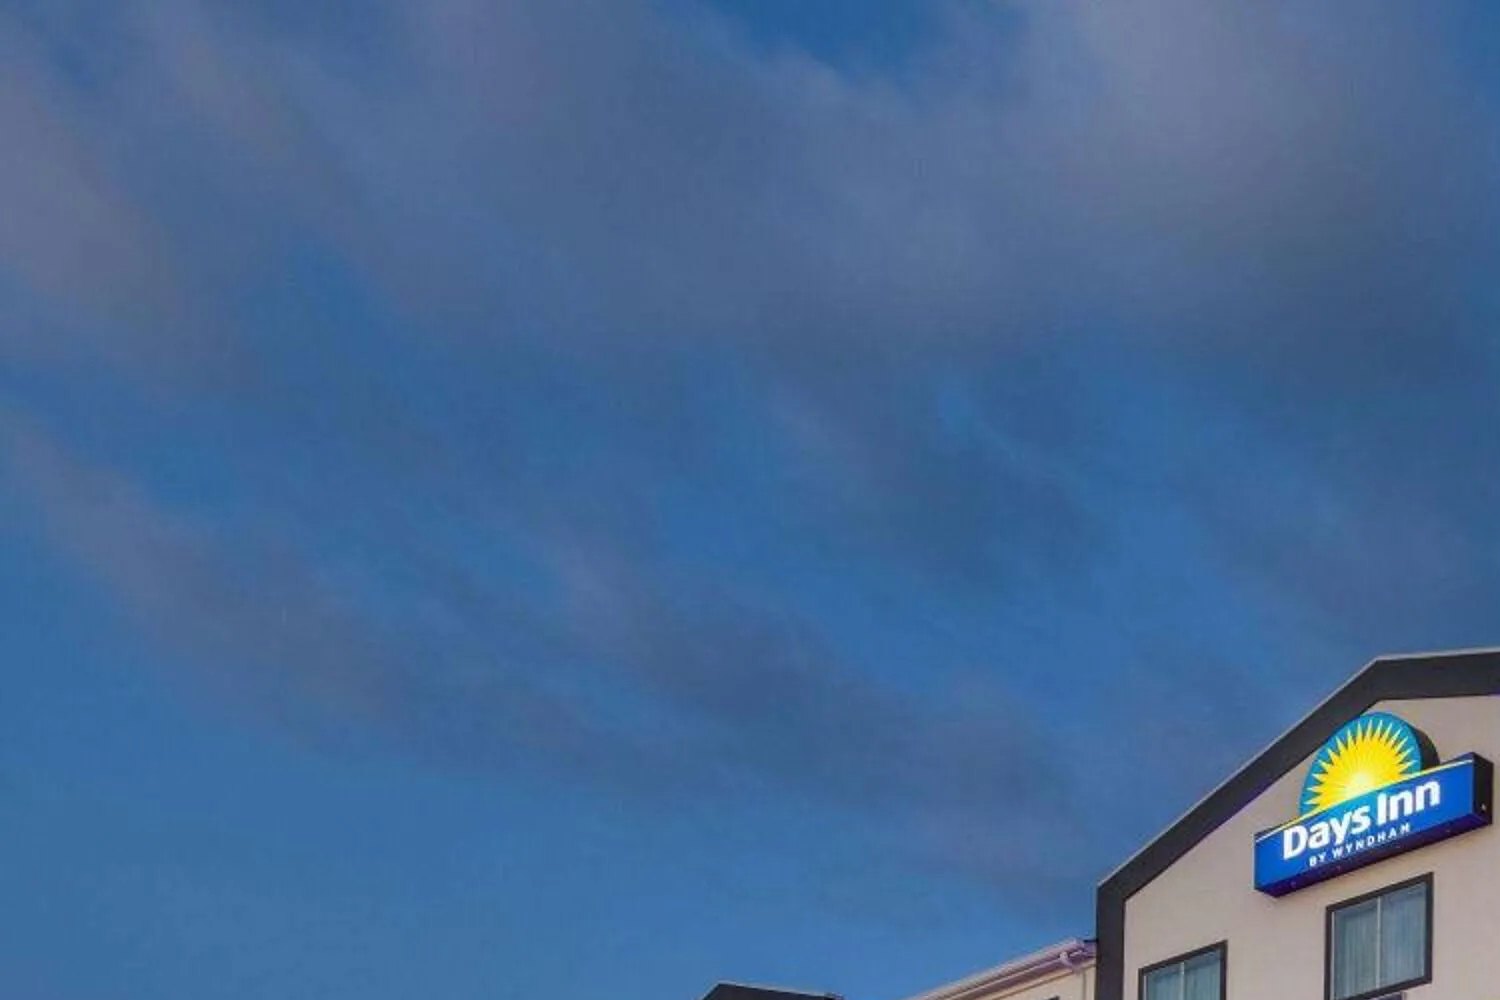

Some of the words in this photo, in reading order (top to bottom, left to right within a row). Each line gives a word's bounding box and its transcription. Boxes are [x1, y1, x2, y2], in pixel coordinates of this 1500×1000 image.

[1283, 804, 1371, 860] Days
[1376, 780, 1441, 826] Inn
[1309, 855, 1326, 867] BY
[1332, 823, 1410, 858] WYNDHAM
